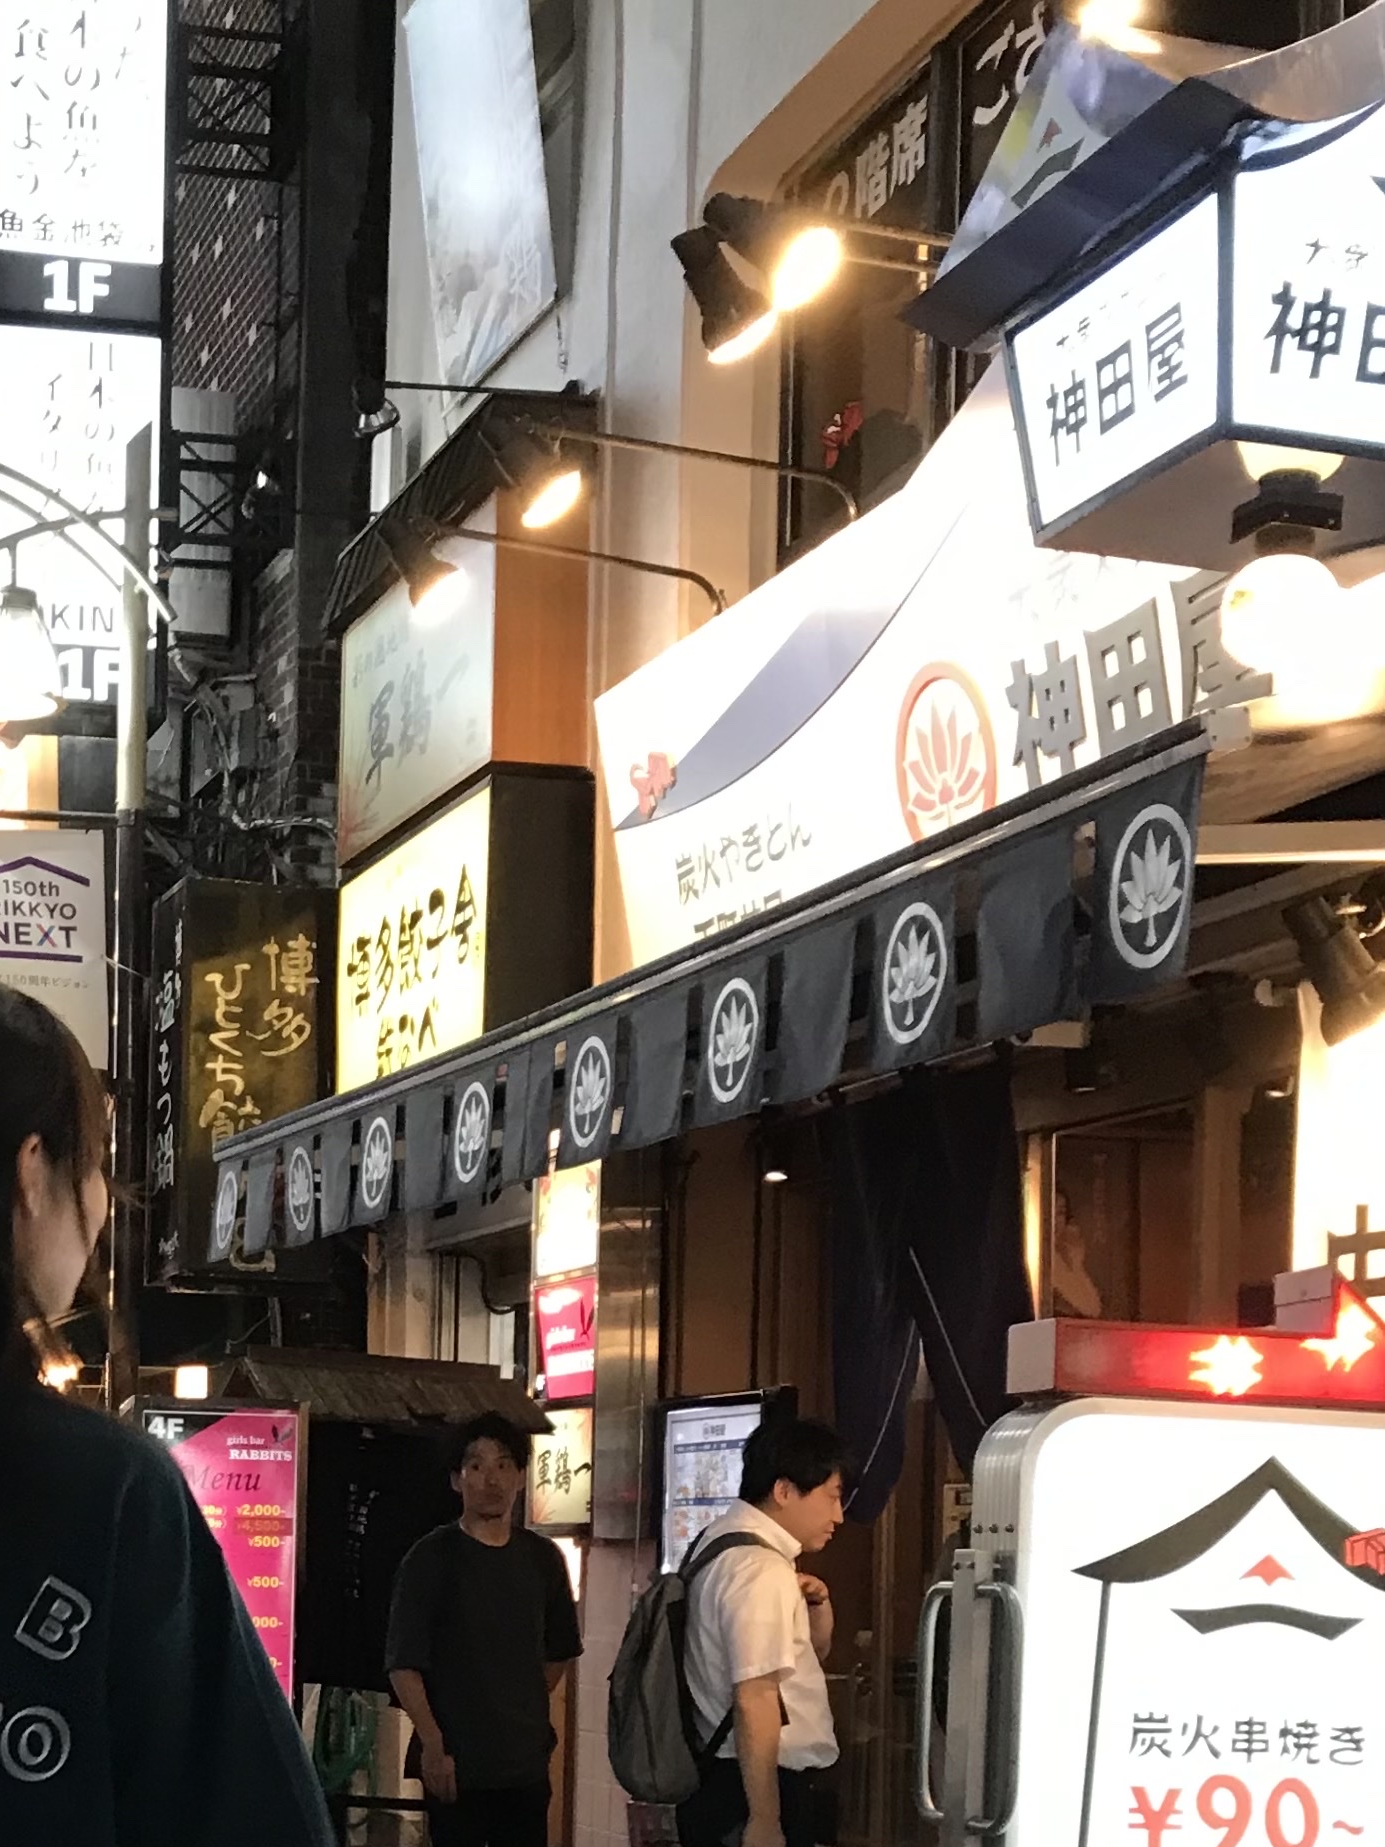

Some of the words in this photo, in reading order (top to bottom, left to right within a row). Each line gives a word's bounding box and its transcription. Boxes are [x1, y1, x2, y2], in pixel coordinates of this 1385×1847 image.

[43, 259, 112, 314] 1F
[1046, 302, 1189, 467] 神田屋
[675, 801, 812, 906] 炭火やきとん
[2, 879, 60, 897] 150th
[245, 932, 321, 1057] 博多
[147, 1416, 185, 1440] 4F
[226, 1434, 249, 1447] girls
[249, 1435, 266, 1446] bar
[228, 1449, 293, 1462] RABBITS
[186, 1464, 262, 1492] Menu
[1128, 1711, 1366, 1767] 炭火串焼き
